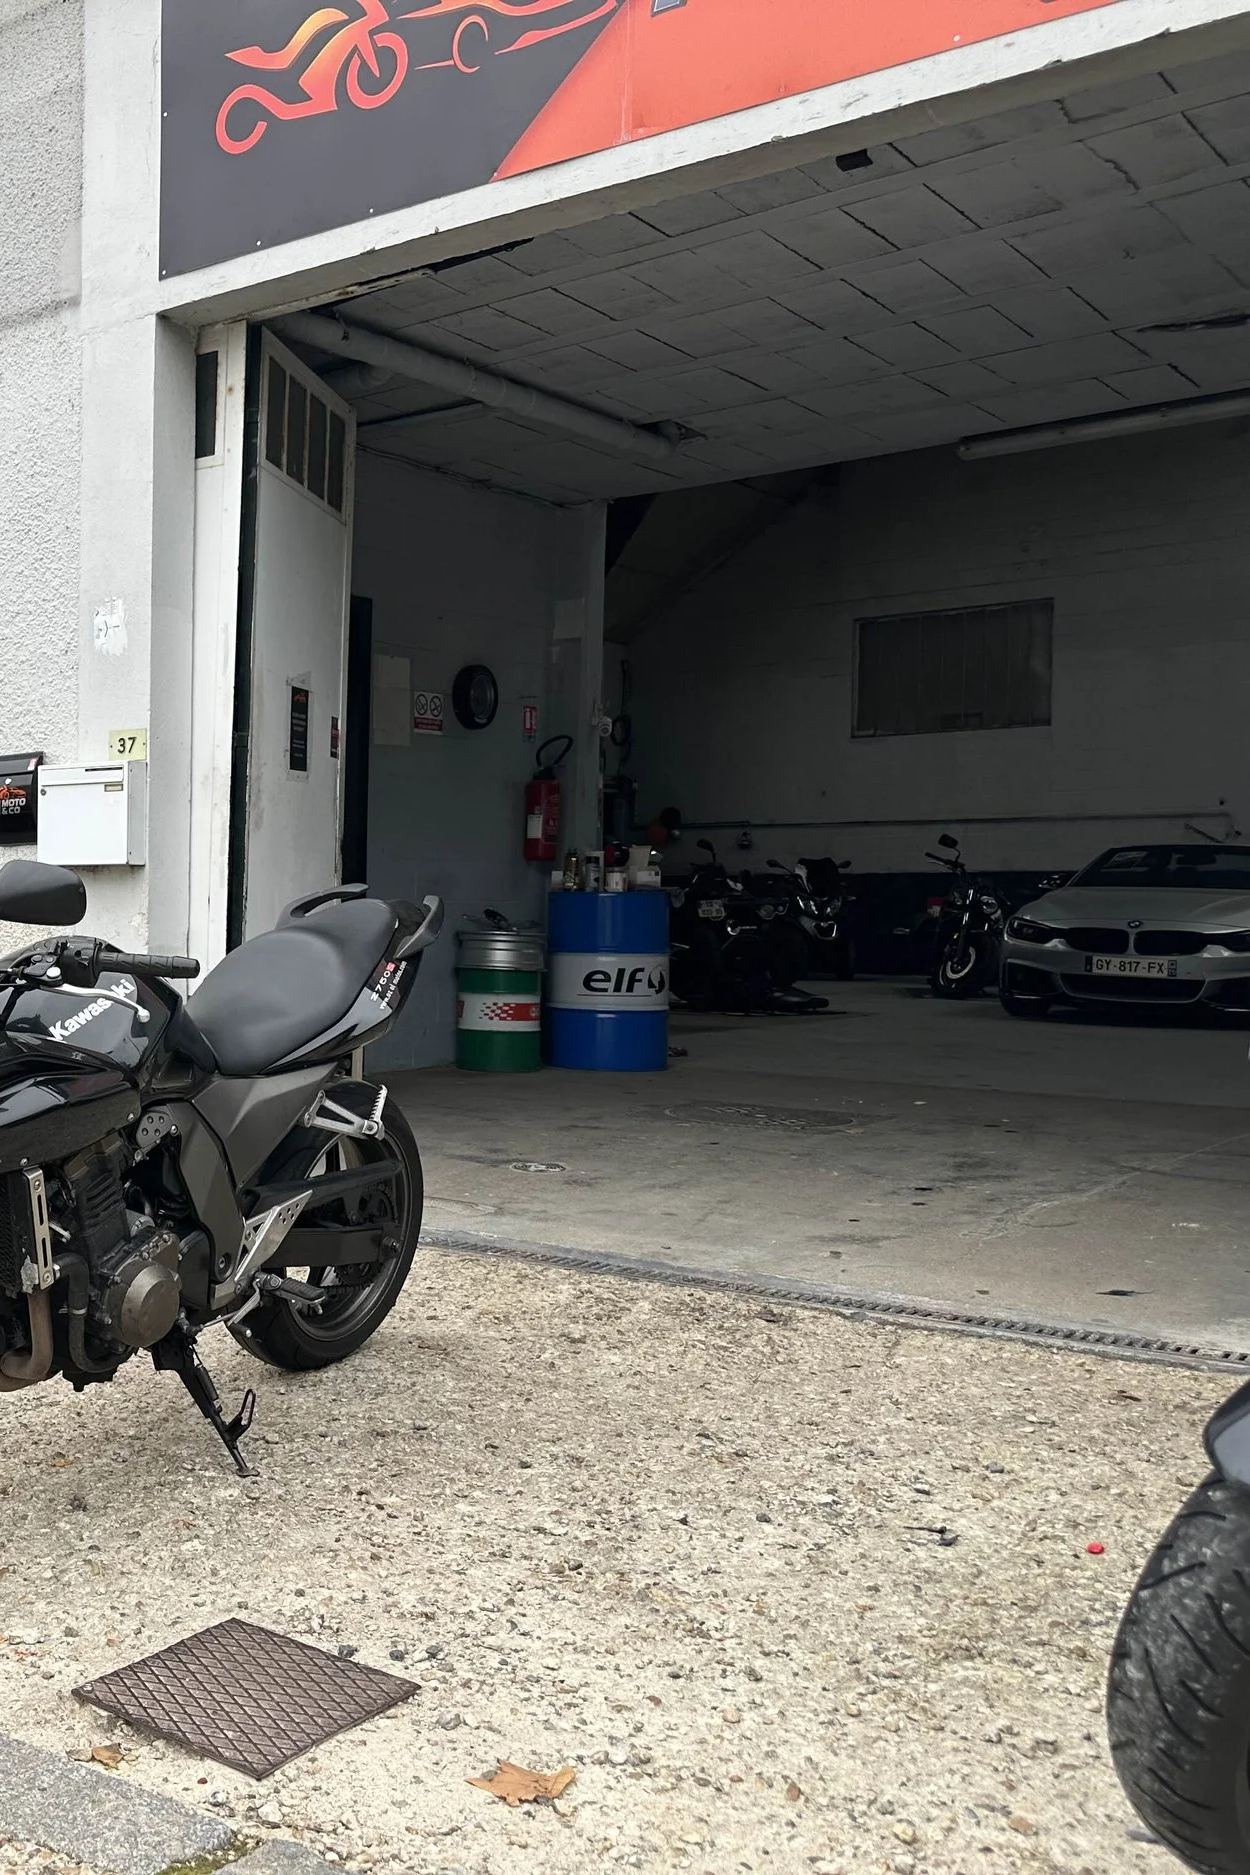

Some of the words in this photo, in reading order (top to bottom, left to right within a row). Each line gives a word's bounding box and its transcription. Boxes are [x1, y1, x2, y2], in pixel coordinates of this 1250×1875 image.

[117, 737, 137, 754] 37
[1, 797, 26, 808] MOTO
[1095, 958, 1165, 975] GY-817-FX
[370, 962, 396, 1002] Z750S
[582, 967, 645, 993] elf
[48, 978, 136, 1041] Kawaski
